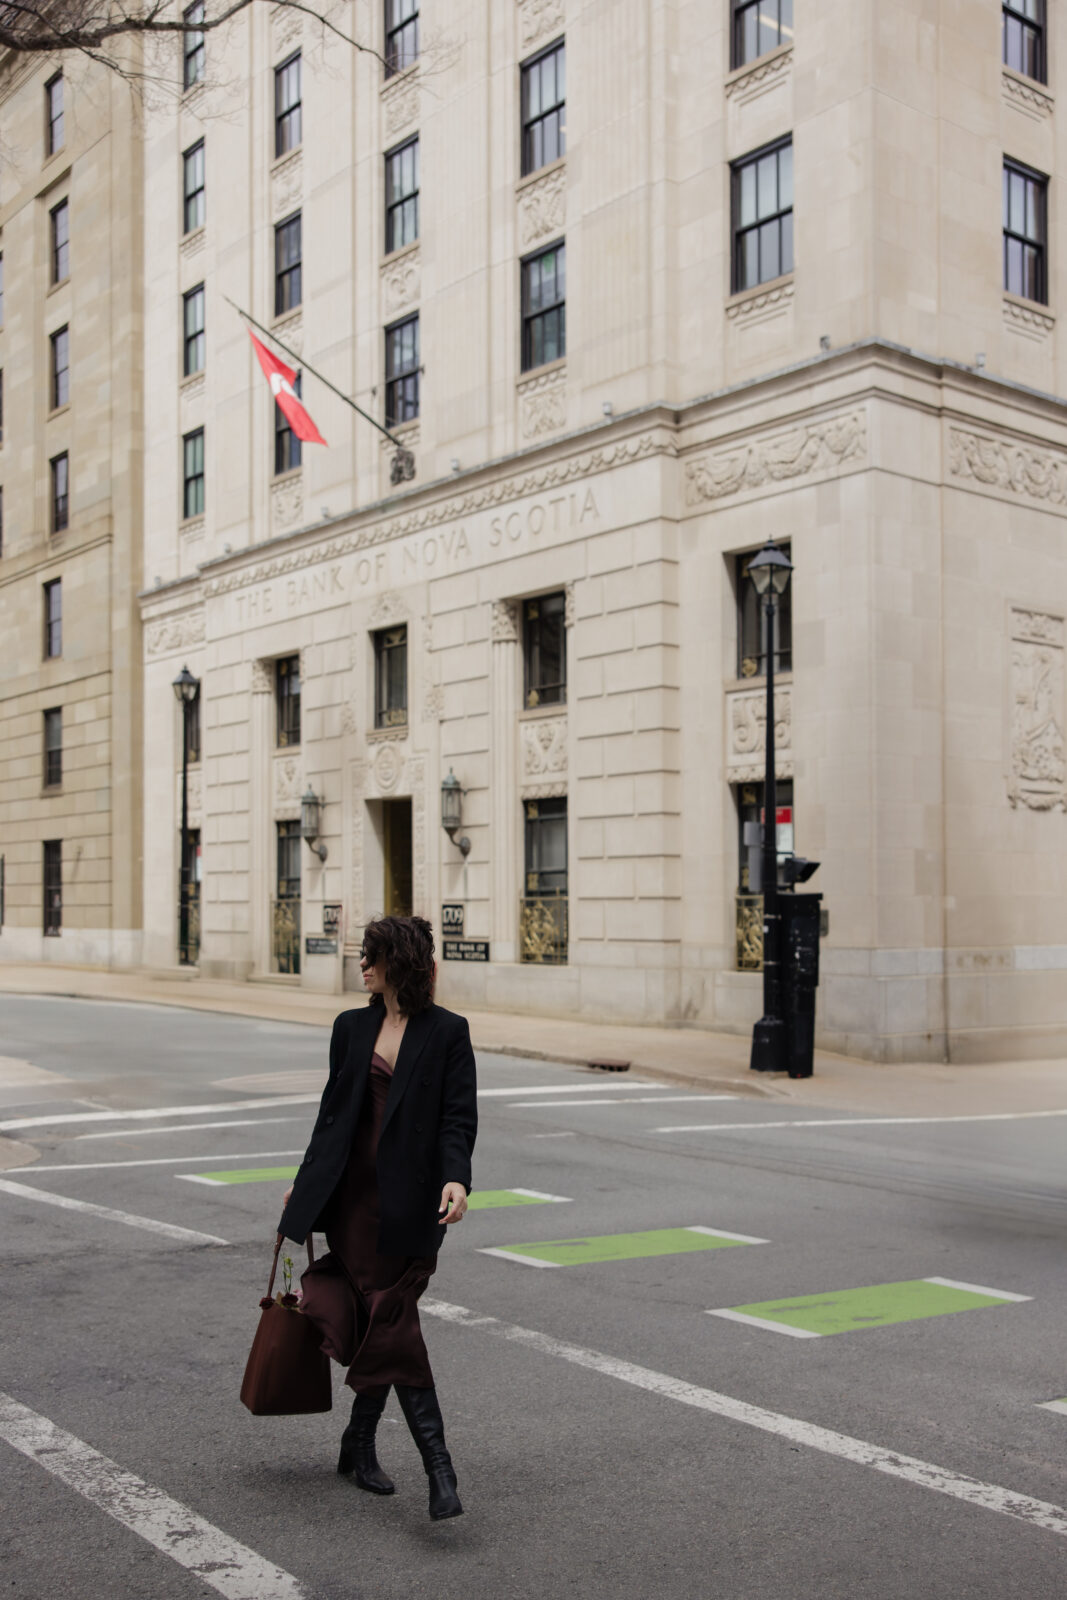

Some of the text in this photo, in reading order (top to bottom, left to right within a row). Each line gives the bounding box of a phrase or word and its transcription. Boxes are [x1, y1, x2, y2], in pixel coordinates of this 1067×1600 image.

[235, 486, 601, 623] THE BANK OF NOVA SCOTIA
[443, 908, 463, 923] 1709
